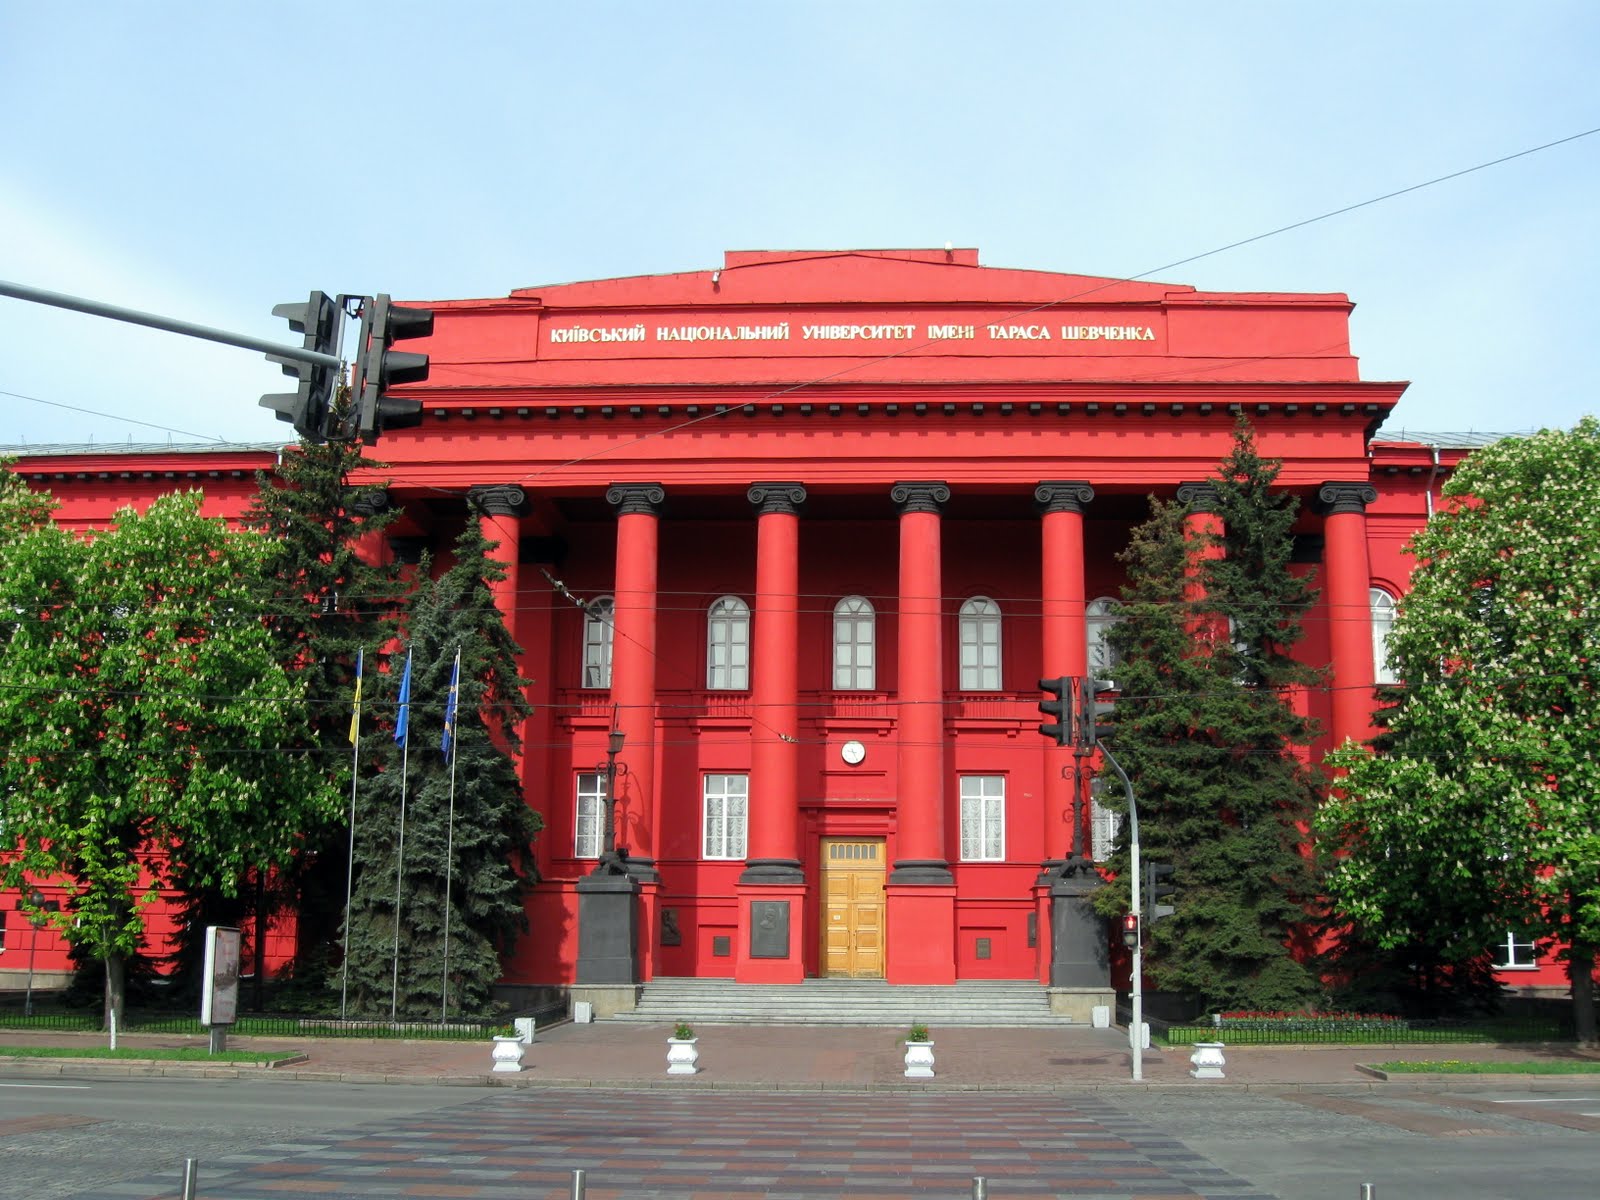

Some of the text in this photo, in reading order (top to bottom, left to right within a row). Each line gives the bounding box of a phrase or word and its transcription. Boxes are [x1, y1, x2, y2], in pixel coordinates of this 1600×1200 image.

[550, 321, 1156, 343] КИЇВСЬКИЙ НАЦІОНАЛЬНИЙ УНІВЕРСИТЕТ ІМЕНІ ТАРАСА ШЕВЧЕНКА
